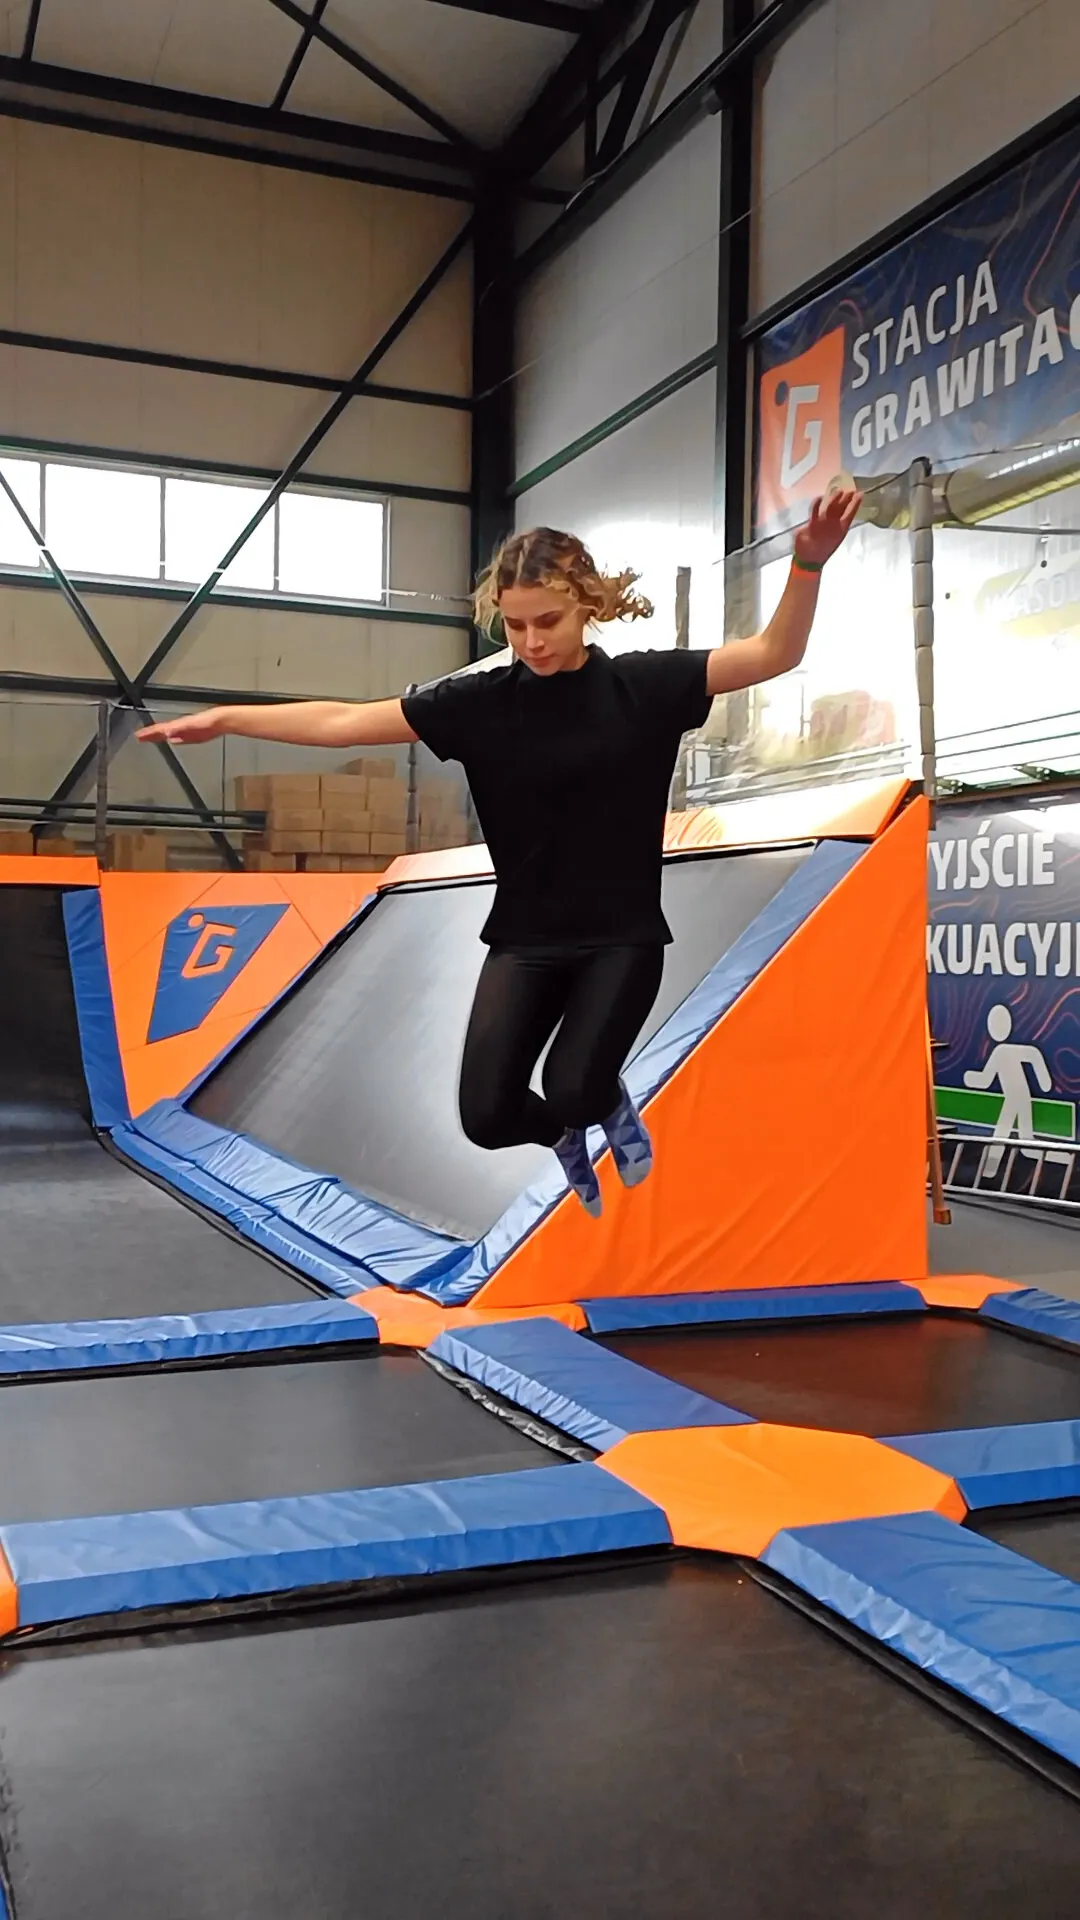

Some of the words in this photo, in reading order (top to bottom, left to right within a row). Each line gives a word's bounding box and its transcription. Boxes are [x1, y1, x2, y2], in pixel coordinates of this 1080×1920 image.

[851, 260, 999, 390] STACJA
[927, 819, 1056, 891] YJŚCIE
[926, 921, 1080, 978] KUACYJ
